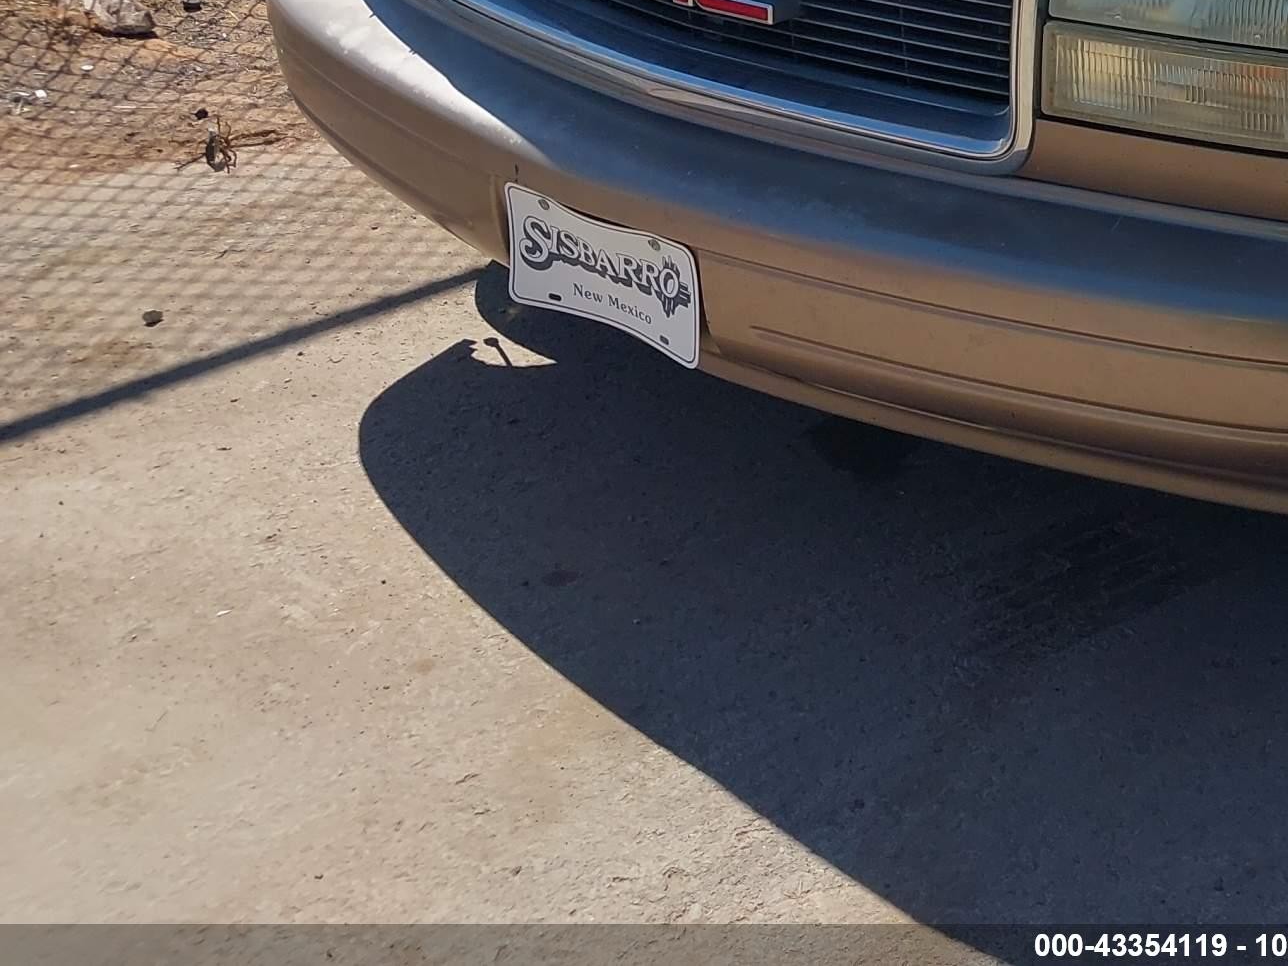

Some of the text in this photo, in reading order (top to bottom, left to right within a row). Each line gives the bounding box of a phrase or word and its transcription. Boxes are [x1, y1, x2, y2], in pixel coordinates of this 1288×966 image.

[519, 215, 682, 300] SISBARRO
[572, 283, 652, 324] New Mexico
